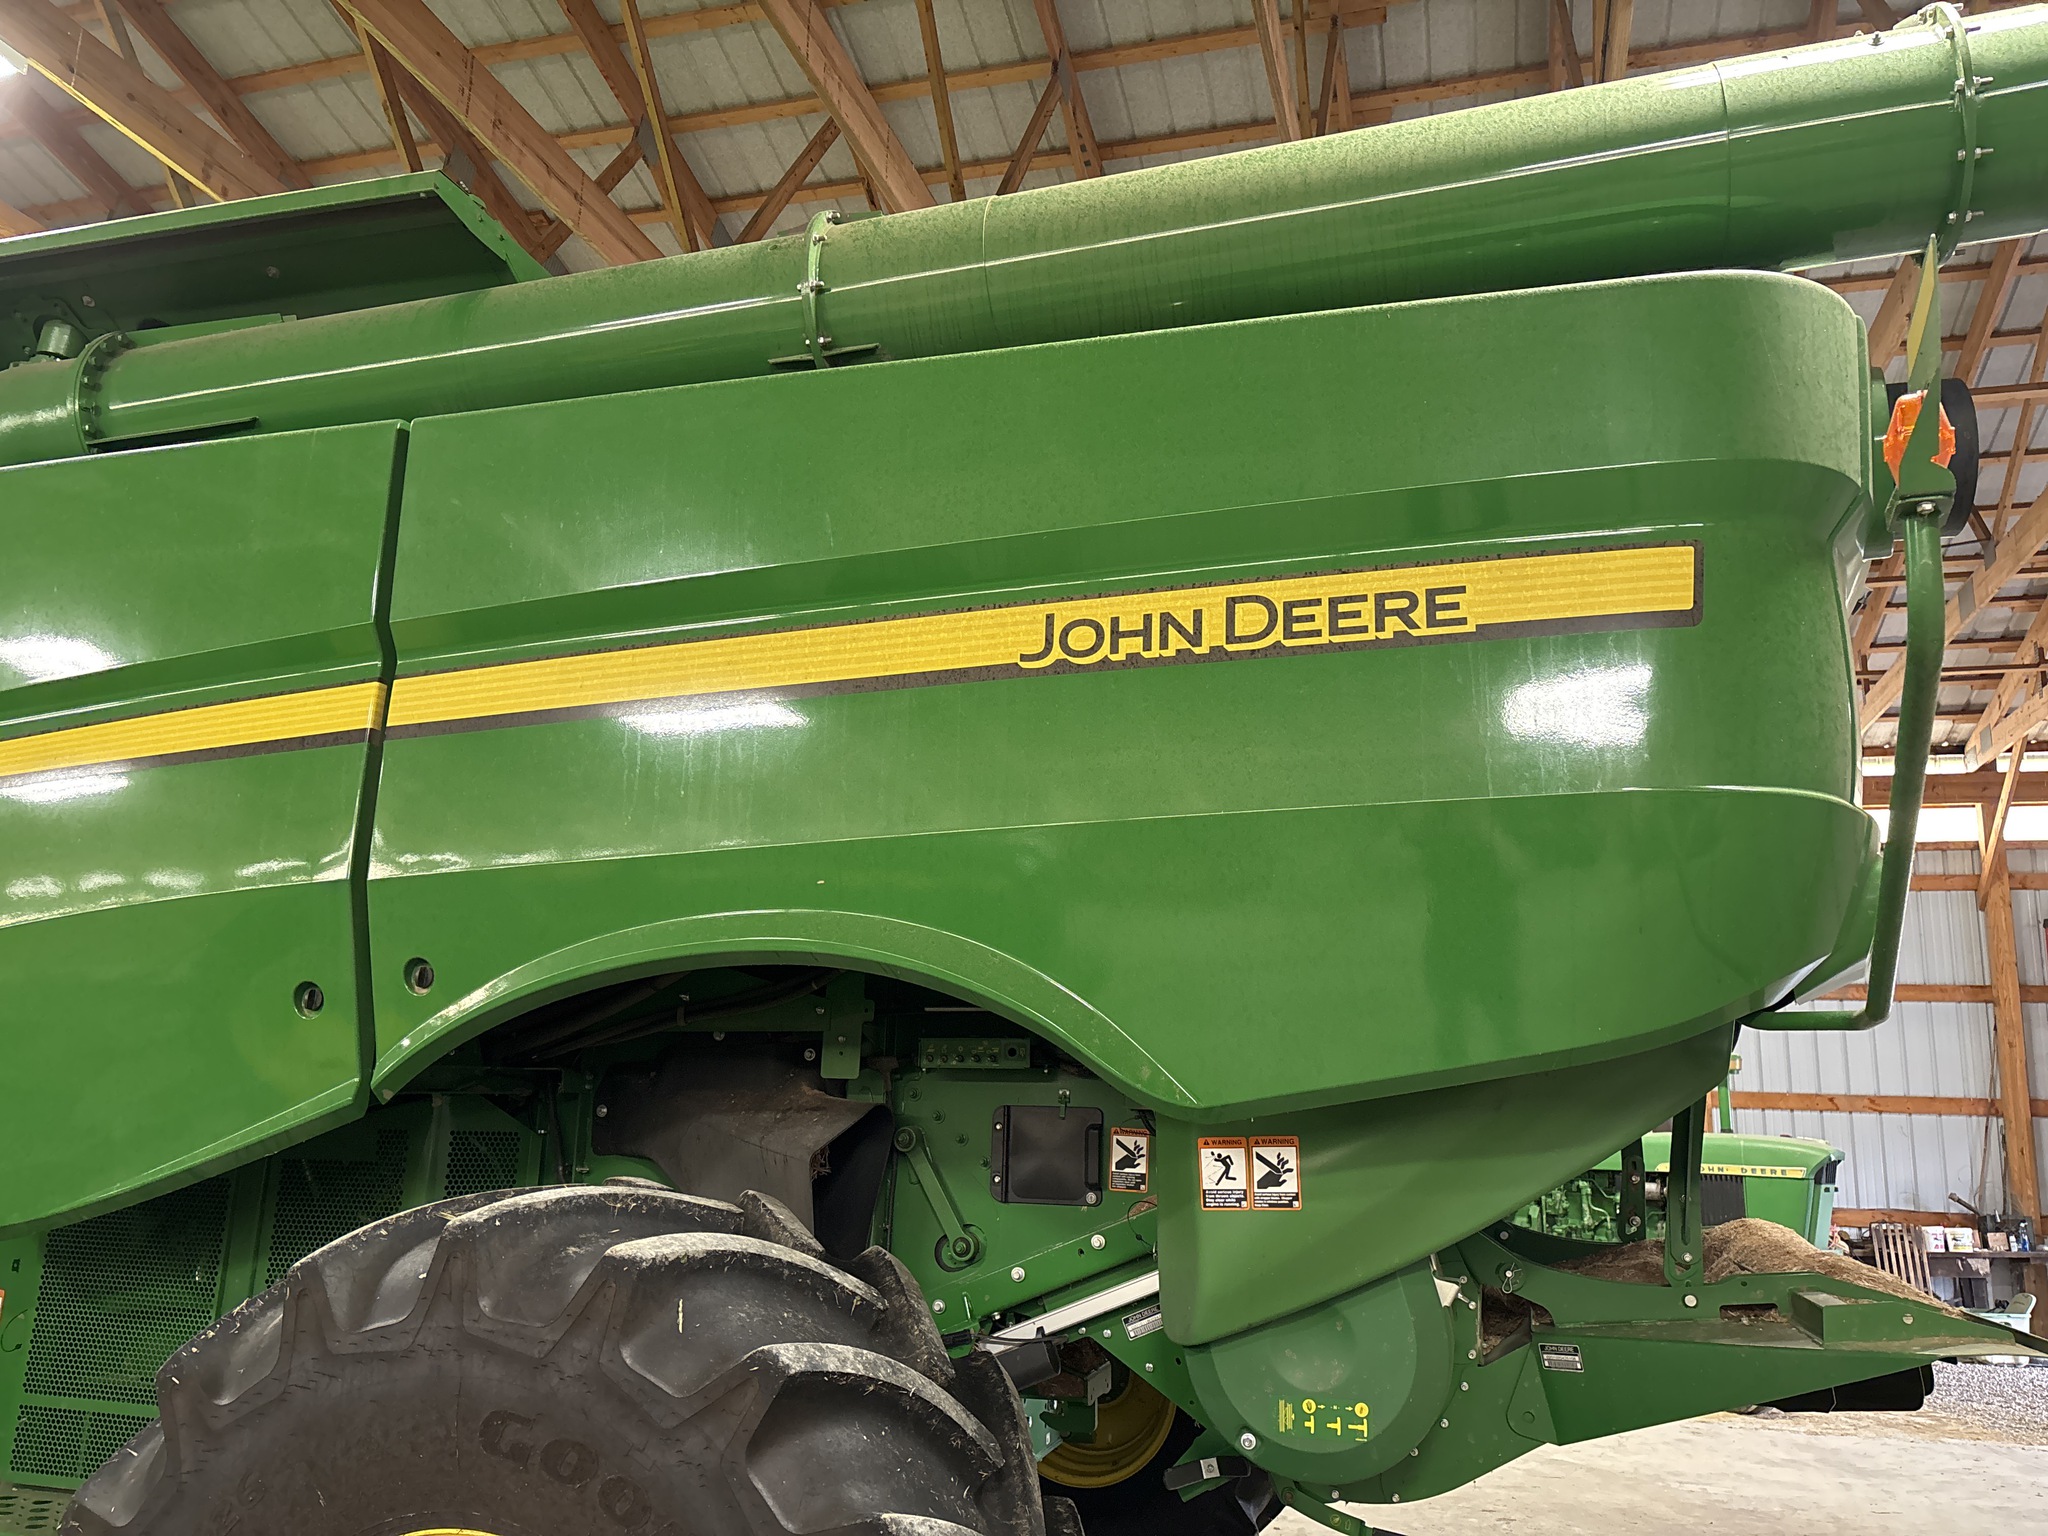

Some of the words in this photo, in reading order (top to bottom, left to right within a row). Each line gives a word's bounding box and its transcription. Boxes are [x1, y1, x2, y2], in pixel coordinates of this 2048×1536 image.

[1019, 608, 1204, 664] JOHN
[1224, 585, 1469, 645] DEERE
[1740, 1167, 1788, 1176] DEERE
[477, 1408, 682, 1536] GOO
